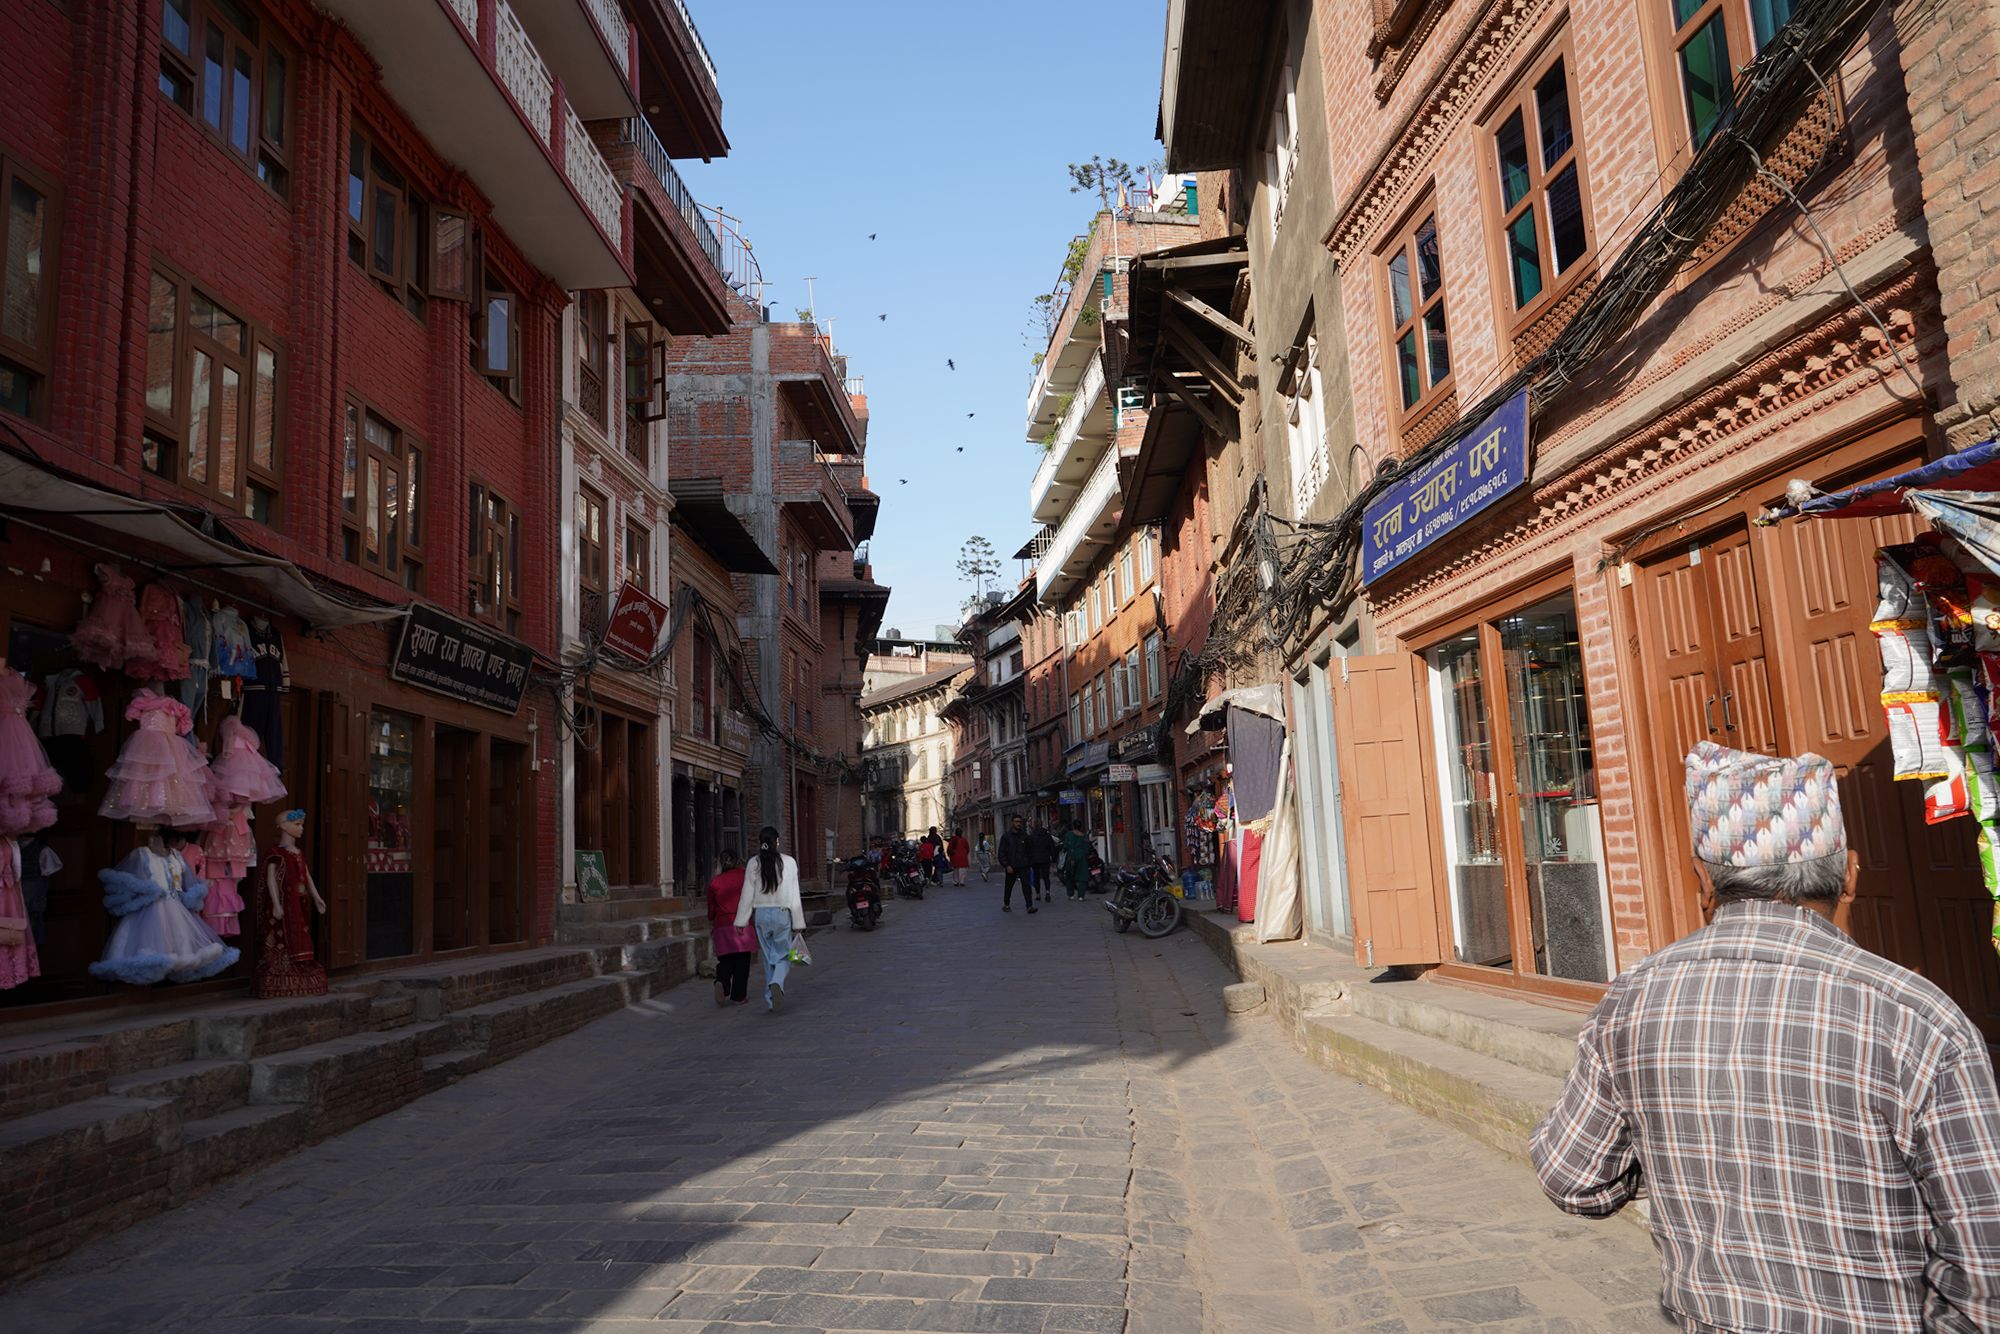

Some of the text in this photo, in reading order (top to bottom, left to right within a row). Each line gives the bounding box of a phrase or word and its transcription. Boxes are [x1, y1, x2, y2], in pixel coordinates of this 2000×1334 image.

[1373, 502, 1404, 549] रत्न
[410, 624, 440, 658] सुगत
[440, 635, 461, 663] राज
[460, 643, 486, 672] शाक्य
[486, 653, 506, 679] एण्ड
